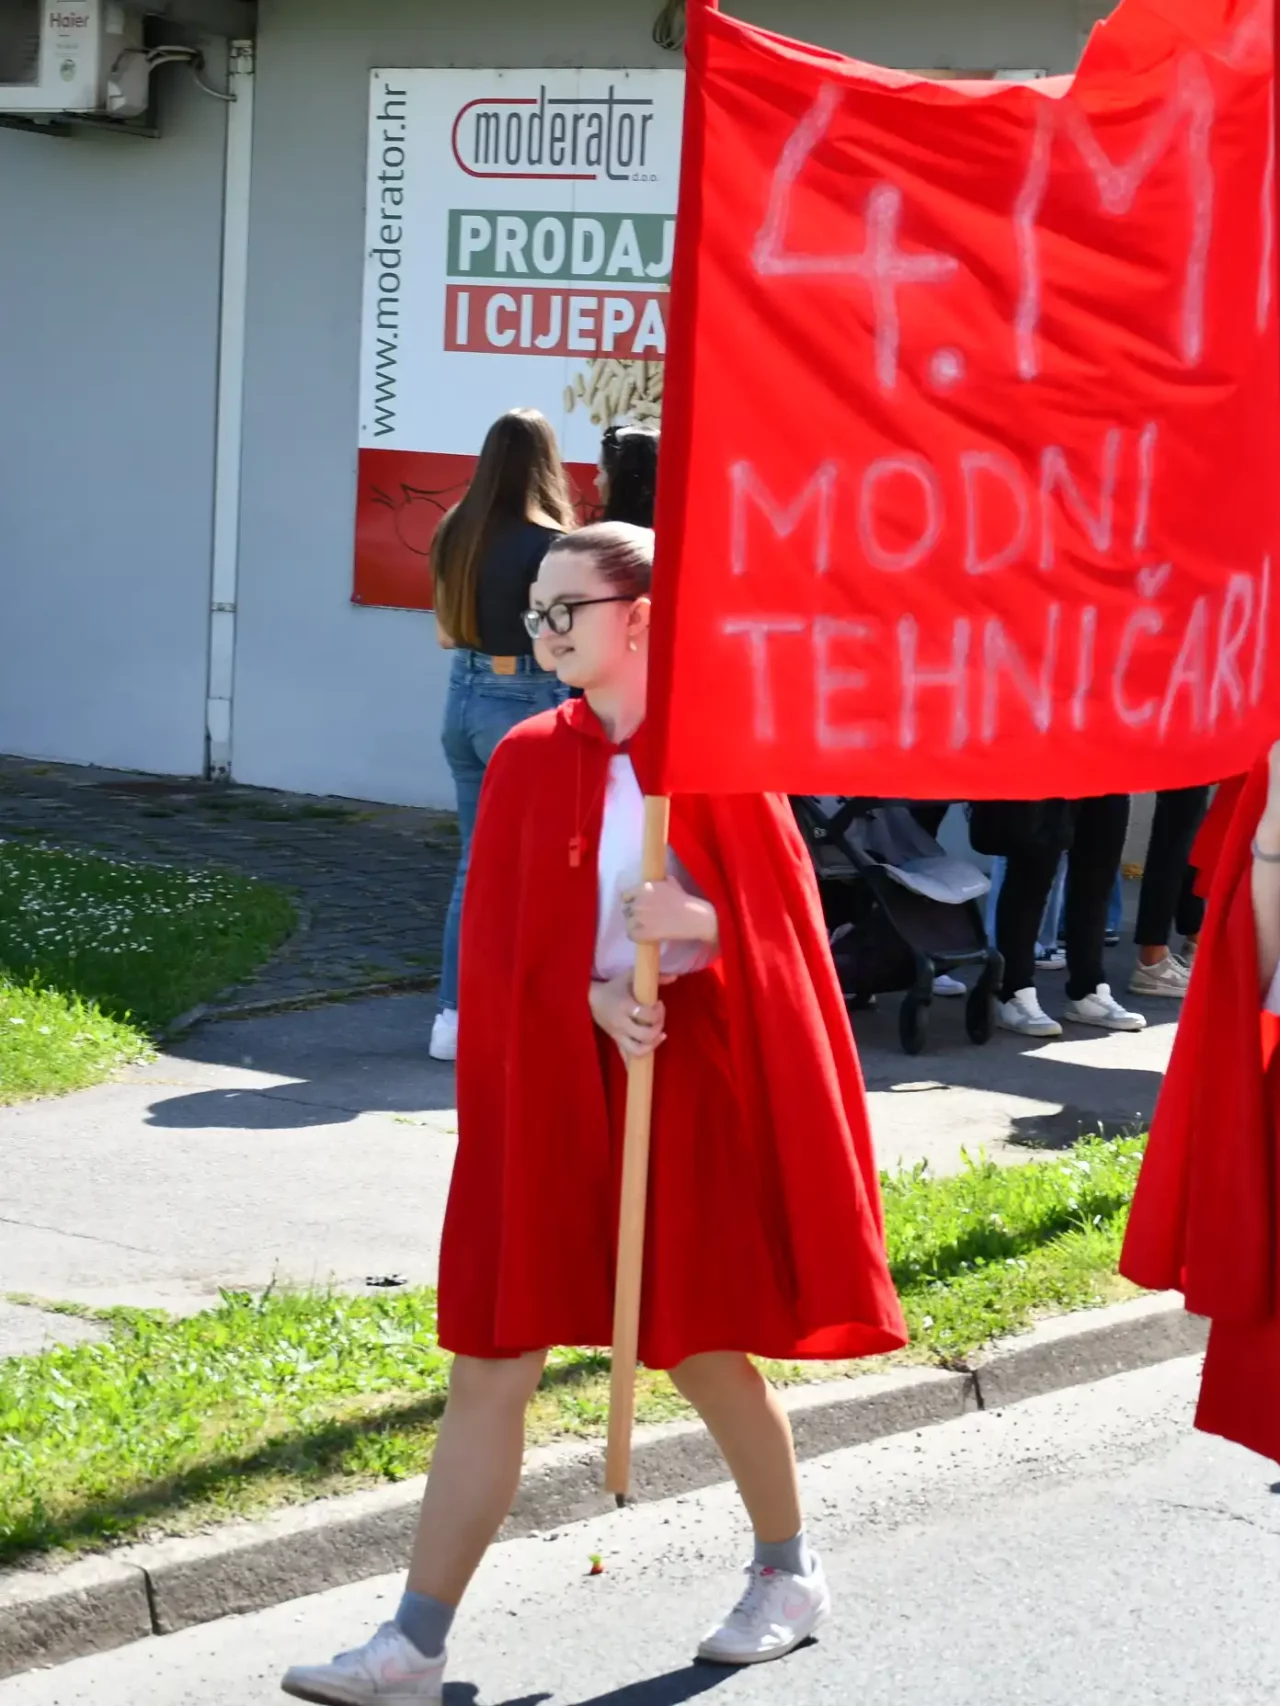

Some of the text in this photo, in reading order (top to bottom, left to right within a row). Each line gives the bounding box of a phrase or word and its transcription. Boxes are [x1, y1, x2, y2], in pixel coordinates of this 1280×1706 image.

[49, 12, 89, 28] Haier
[474, 84, 653, 180] moderator
[373, 83, 407, 437] www.moderator.hr
[458, 214, 676, 278] PRODAJ
[456, 291, 667, 355] I CIJEPA
[729, 420, 1158, 577] MODNI
[720, 553, 1271, 752] TEHNIČARI
